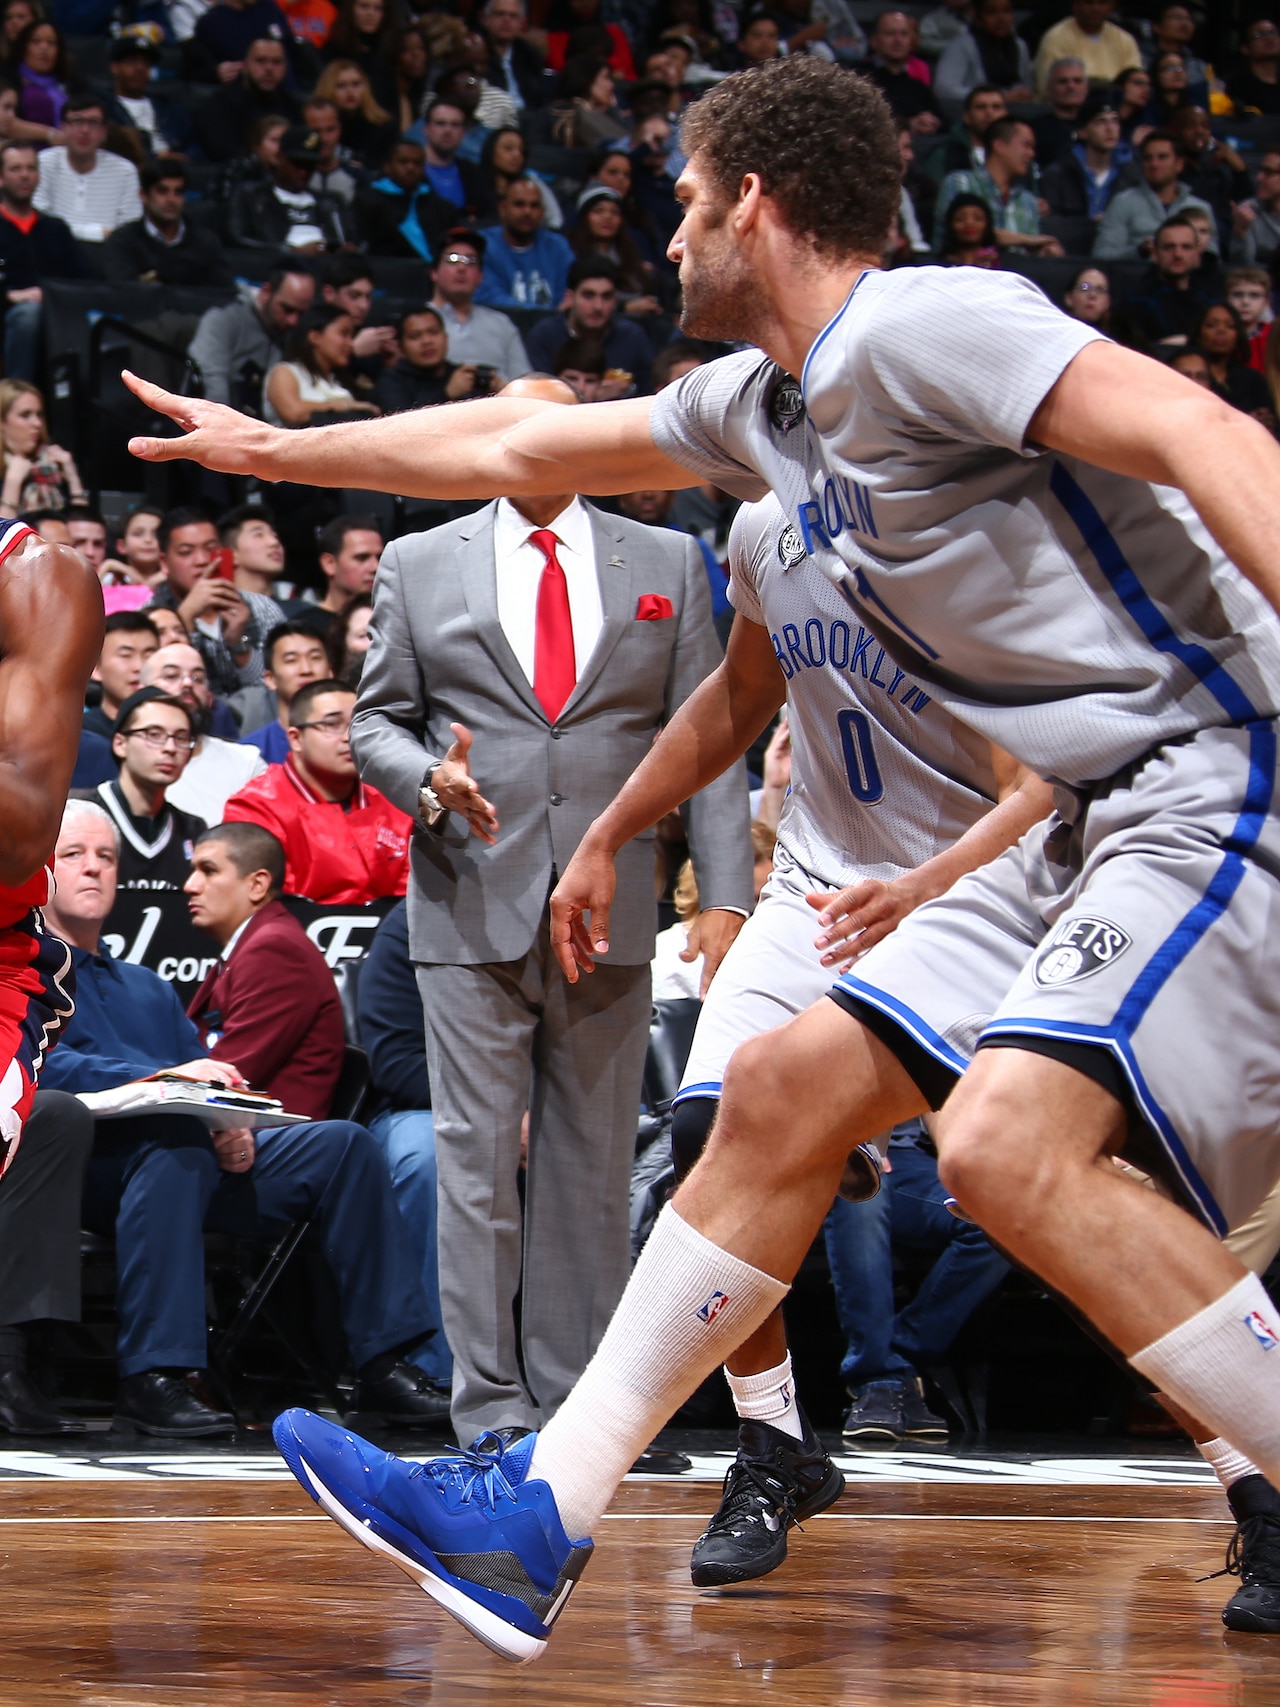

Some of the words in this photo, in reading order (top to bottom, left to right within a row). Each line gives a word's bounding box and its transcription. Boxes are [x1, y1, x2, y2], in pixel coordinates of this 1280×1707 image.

[771, 618, 932, 715] BROOKLYN
[836, 707, 885, 806] 0
[1044, 918, 1123, 961] NETS
